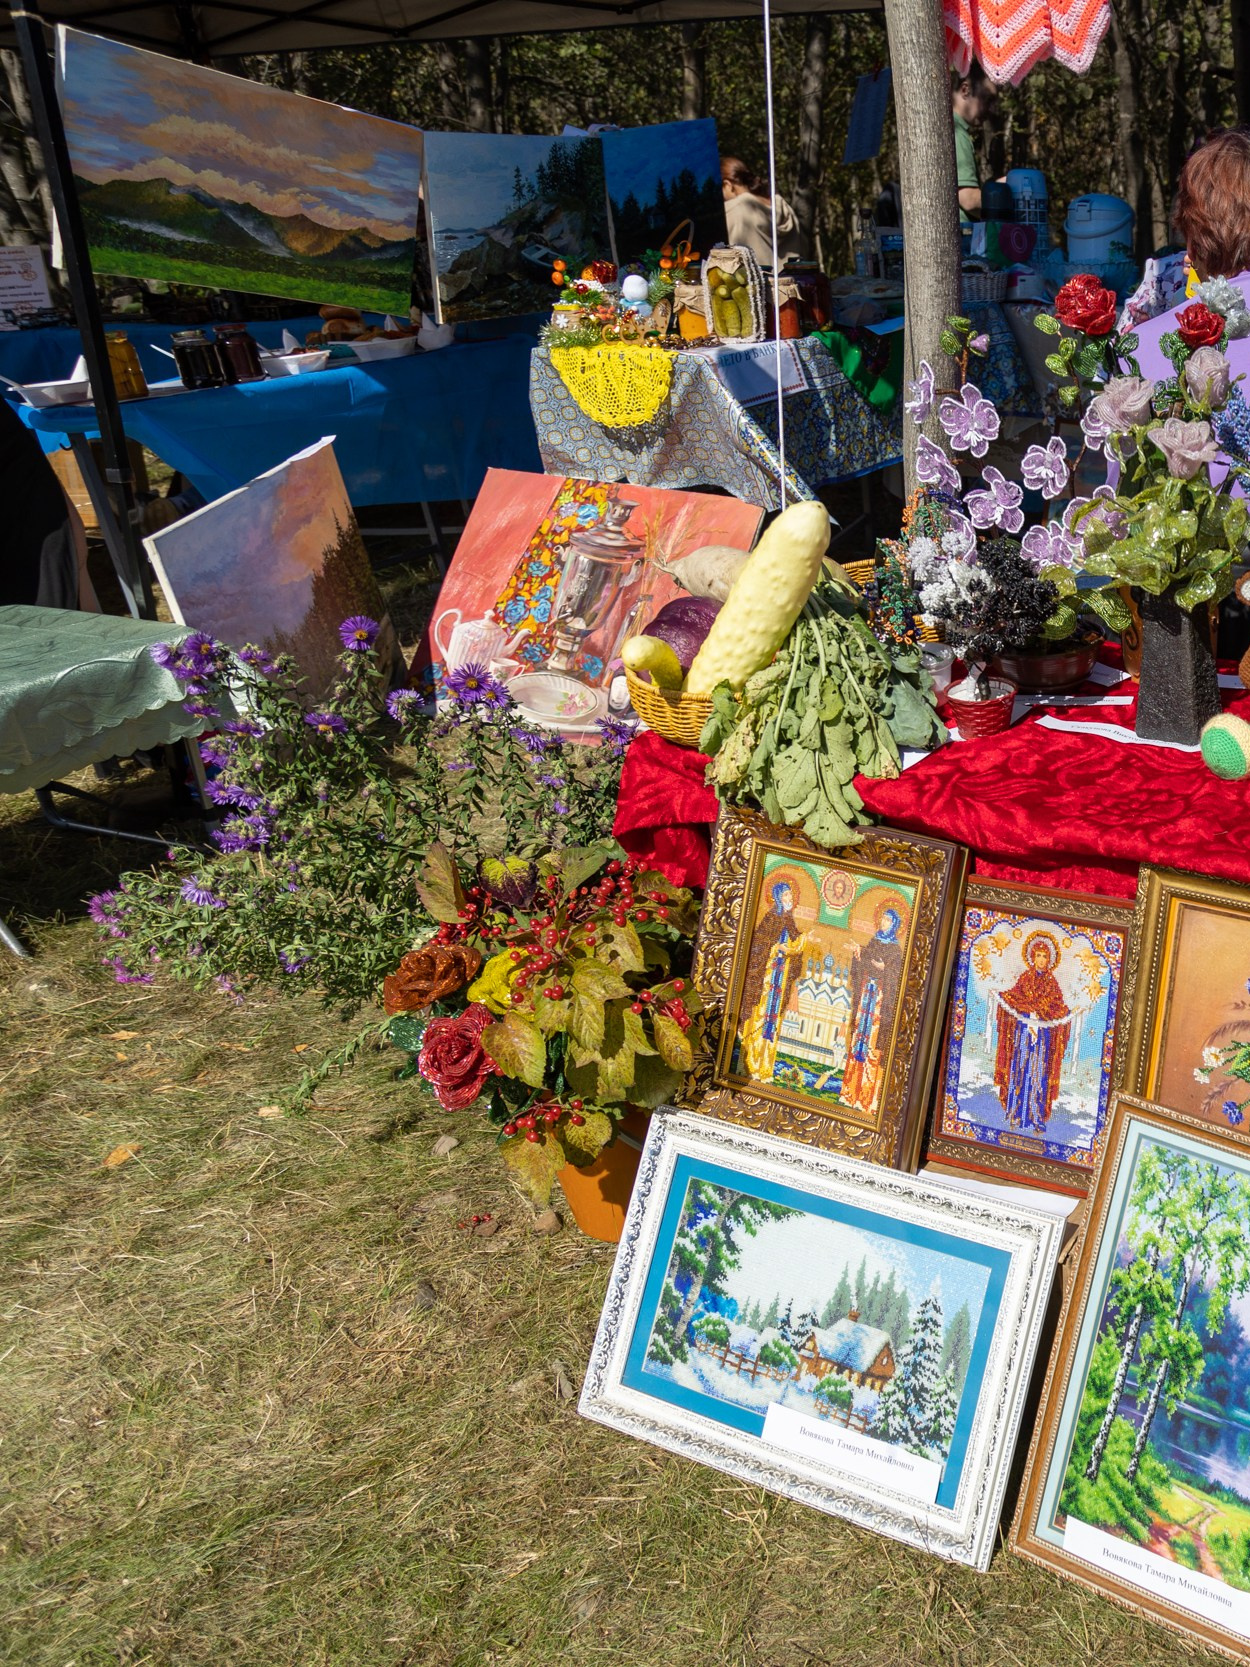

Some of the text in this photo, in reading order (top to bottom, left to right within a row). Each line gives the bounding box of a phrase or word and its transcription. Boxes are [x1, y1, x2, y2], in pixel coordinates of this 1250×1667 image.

[751, 341, 784, 359] БАНК
[836, 1437, 864, 1455] Тамара
[865, 1447, 915, 1472] Михайловна
[1102, 1547, 1233, 1608] Вовякова Тамара Михайловна
